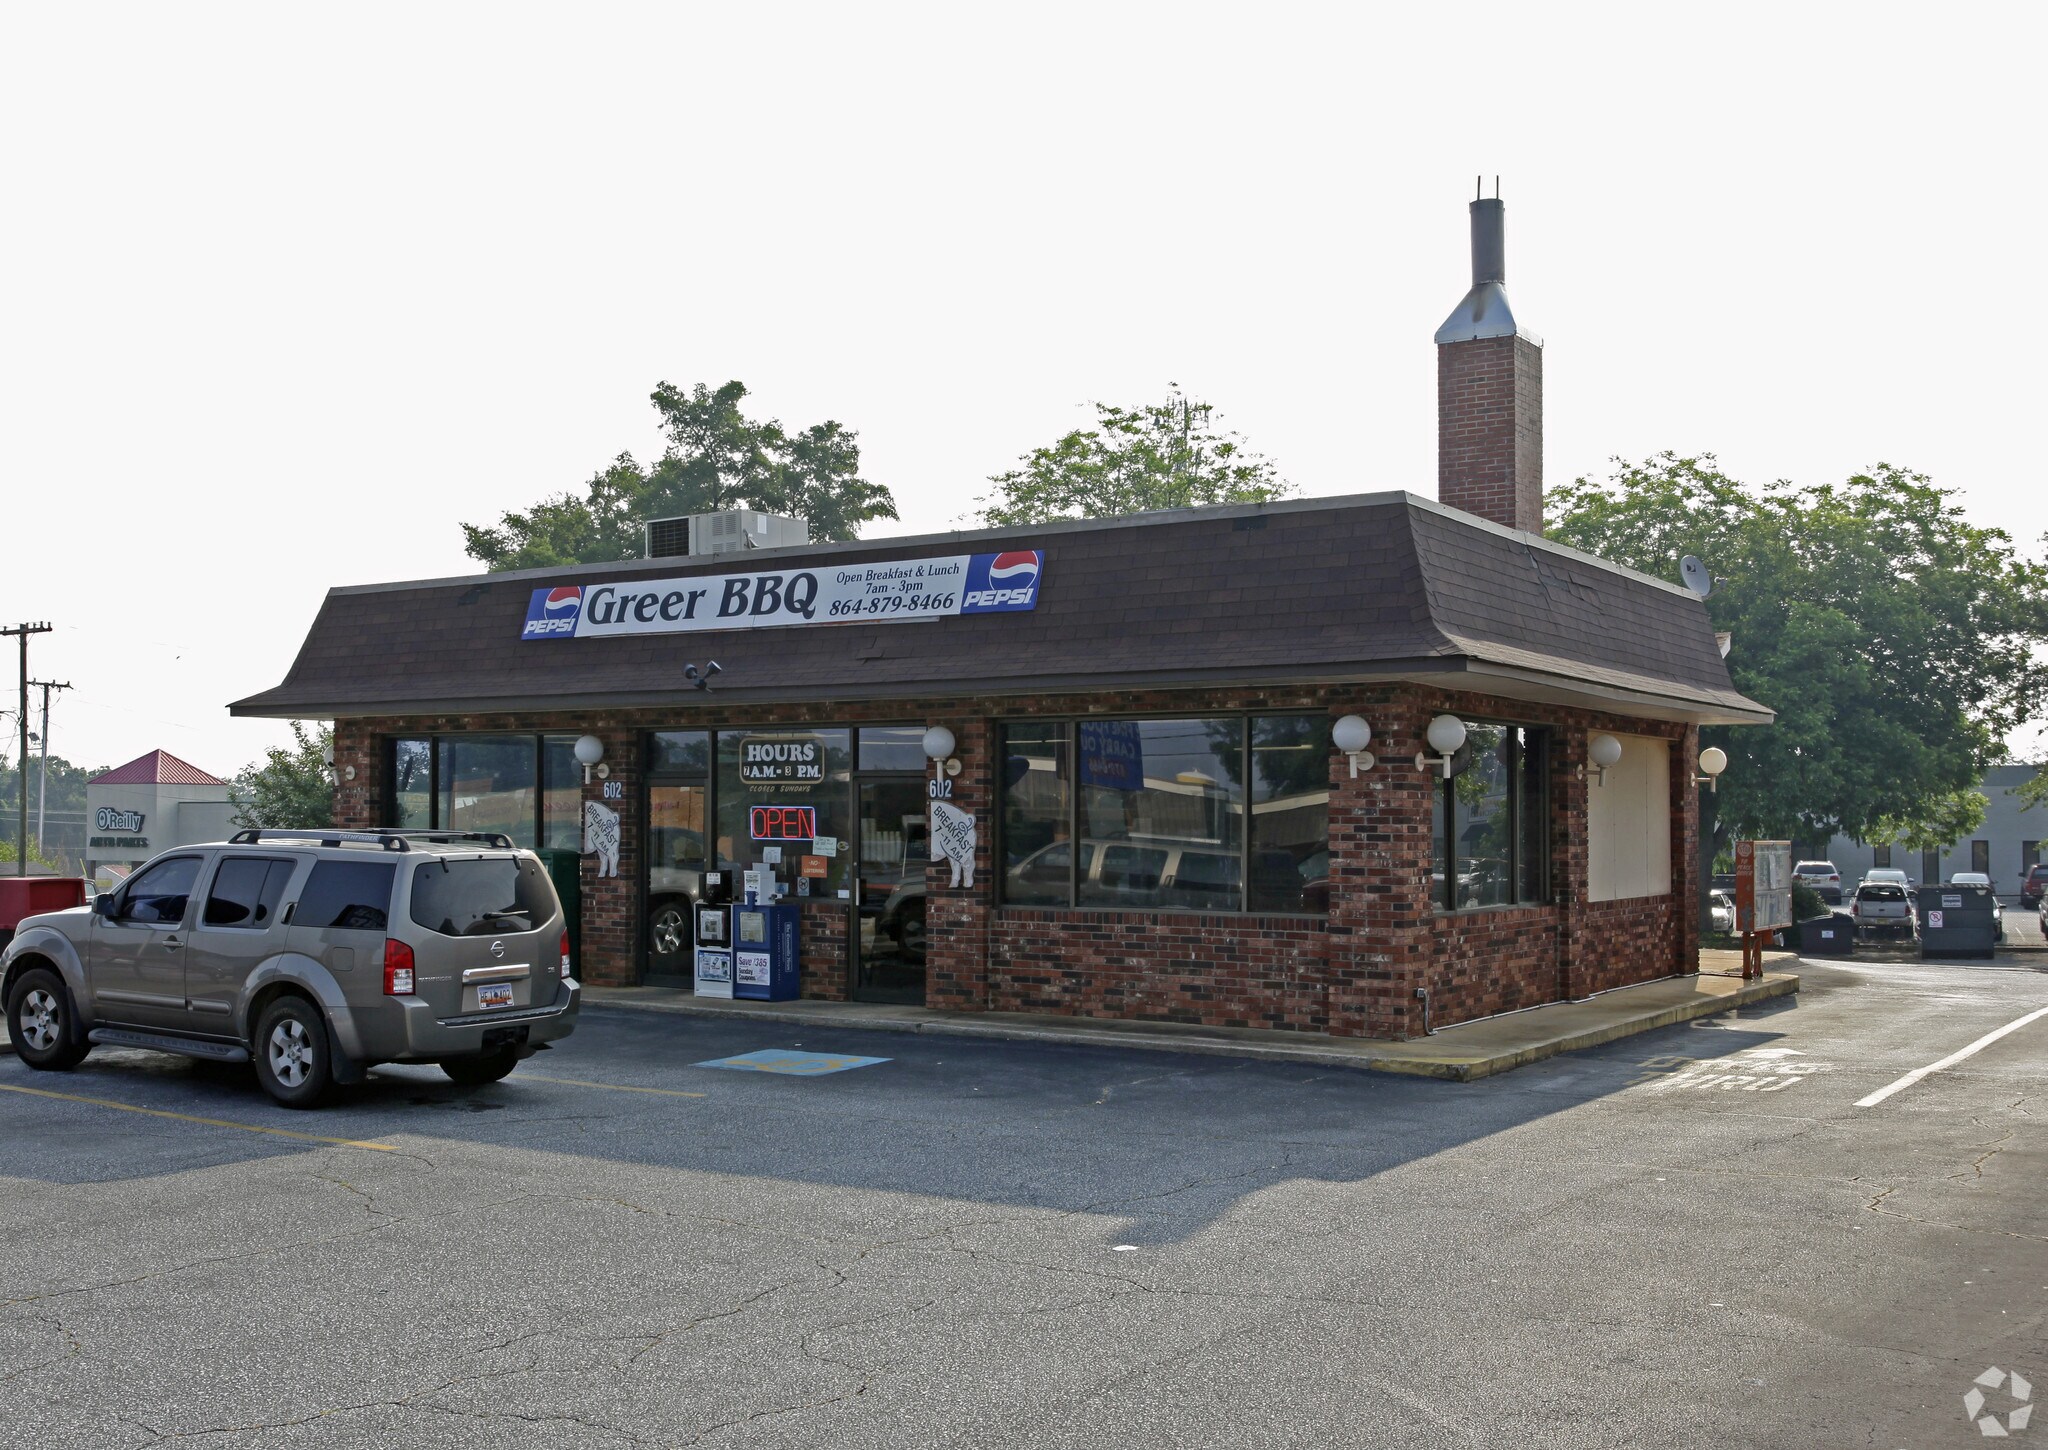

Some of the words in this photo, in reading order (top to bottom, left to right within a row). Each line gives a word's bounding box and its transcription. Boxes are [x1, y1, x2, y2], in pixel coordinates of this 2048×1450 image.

[836, 571, 863, 586] Open
[865, 567, 913, 582] Breakfast
[915, 565, 925, 578] &
[928, 563, 960, 577] Lunch
[865, 582, 888, 595] 7am
[898, 580, 924, 595] 3pm
[587, 587, 707, 625] Greer
[716, 572, 819, 620] BBQ
[829, 592, 956, 616] 864-879-8466
[963, 588, 1034, 607] PEPSI
[523, 618, 576, 635] PEPSI
[747, 744, 815, 762] HOURS
[797, 765, 822, 778] P.M.
[603, 782, 622, 799] 602
[749, 785, 775, 793] CLOSED
[780, 785, 812, 793] SUNDAYS
[929, 779, 952, 798] 602
[96, 808, 142, 832] O'Reilly
[586, 804, 618, 847] BREAKFAST
[752, 808, 815, 839] OPEN
[933, 805, 974, 854] BREAKFAST
[89, 837, 115, 848] AUTO
[116, 837, 149, 848] PARTS
[599, 841, 610, 854] AM
[950, 846, 964, 862] AM
[738, 957, 752, 966] Save
[738, 967, 753, 976] Sunday
